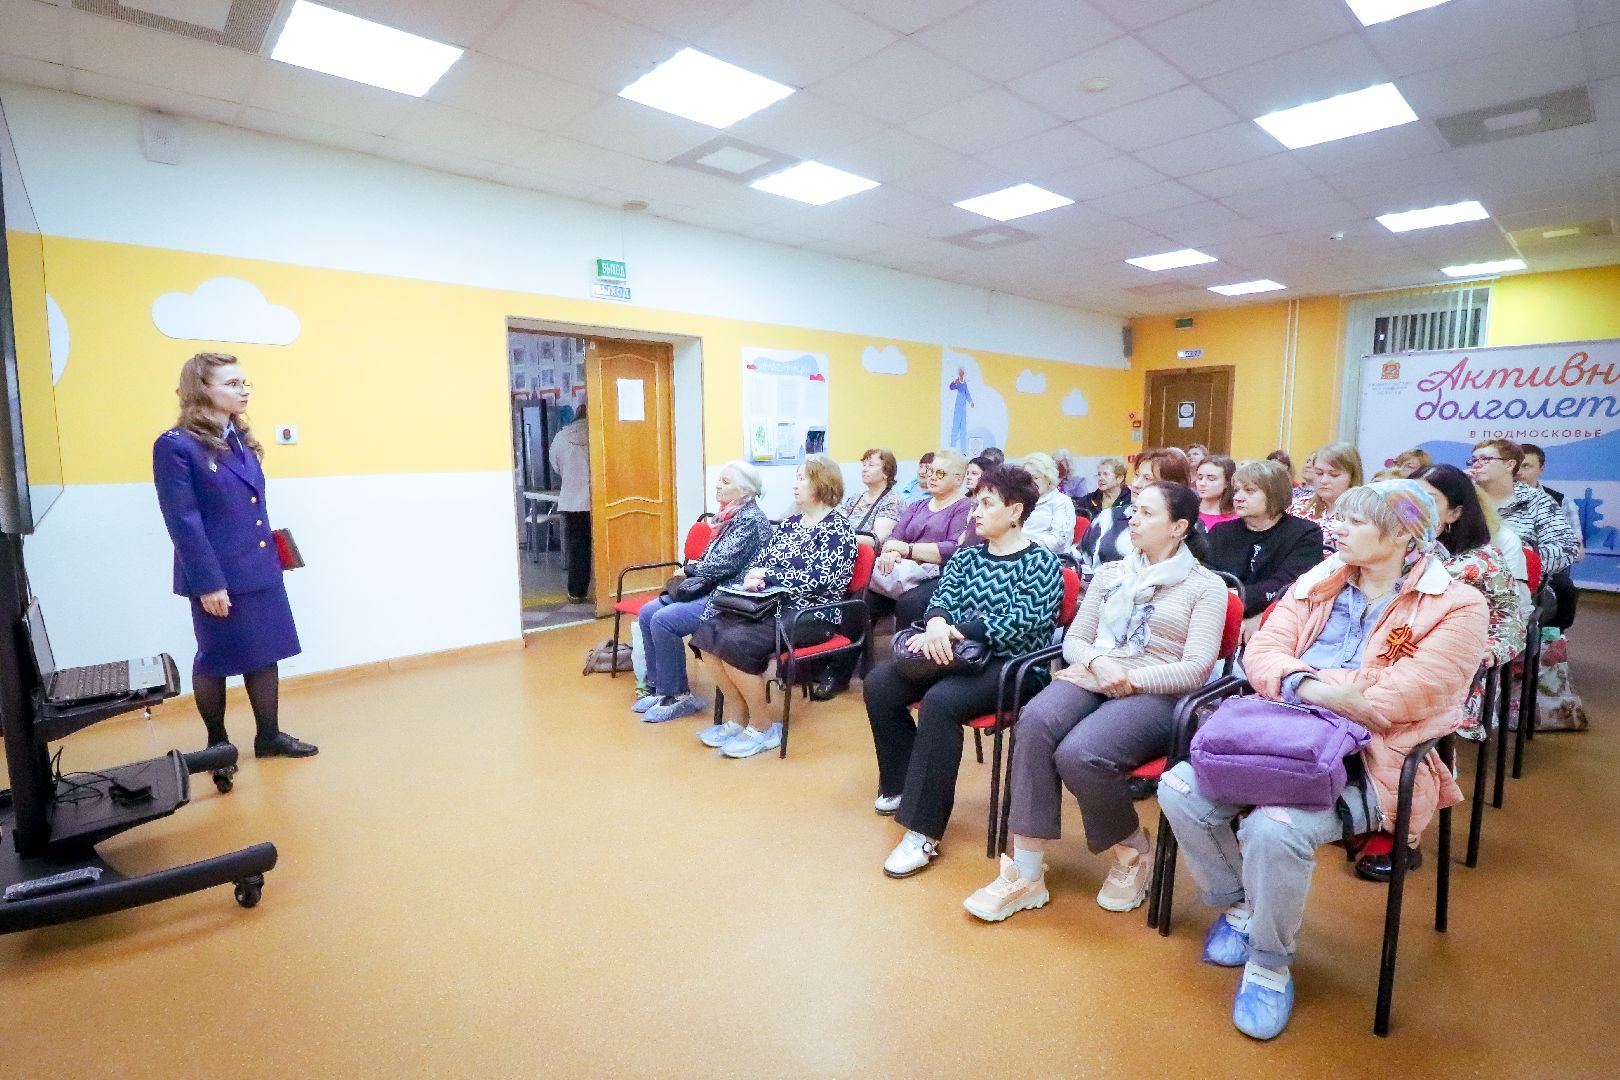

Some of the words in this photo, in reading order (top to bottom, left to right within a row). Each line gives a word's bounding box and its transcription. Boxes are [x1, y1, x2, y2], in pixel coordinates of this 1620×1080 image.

[602, 262, 625, 277] ВЫХОД
[593, 284, 630, 299] ВЫХОД
[1483, 428, 1601, 440] ПОДМОСКОВЬЕ
